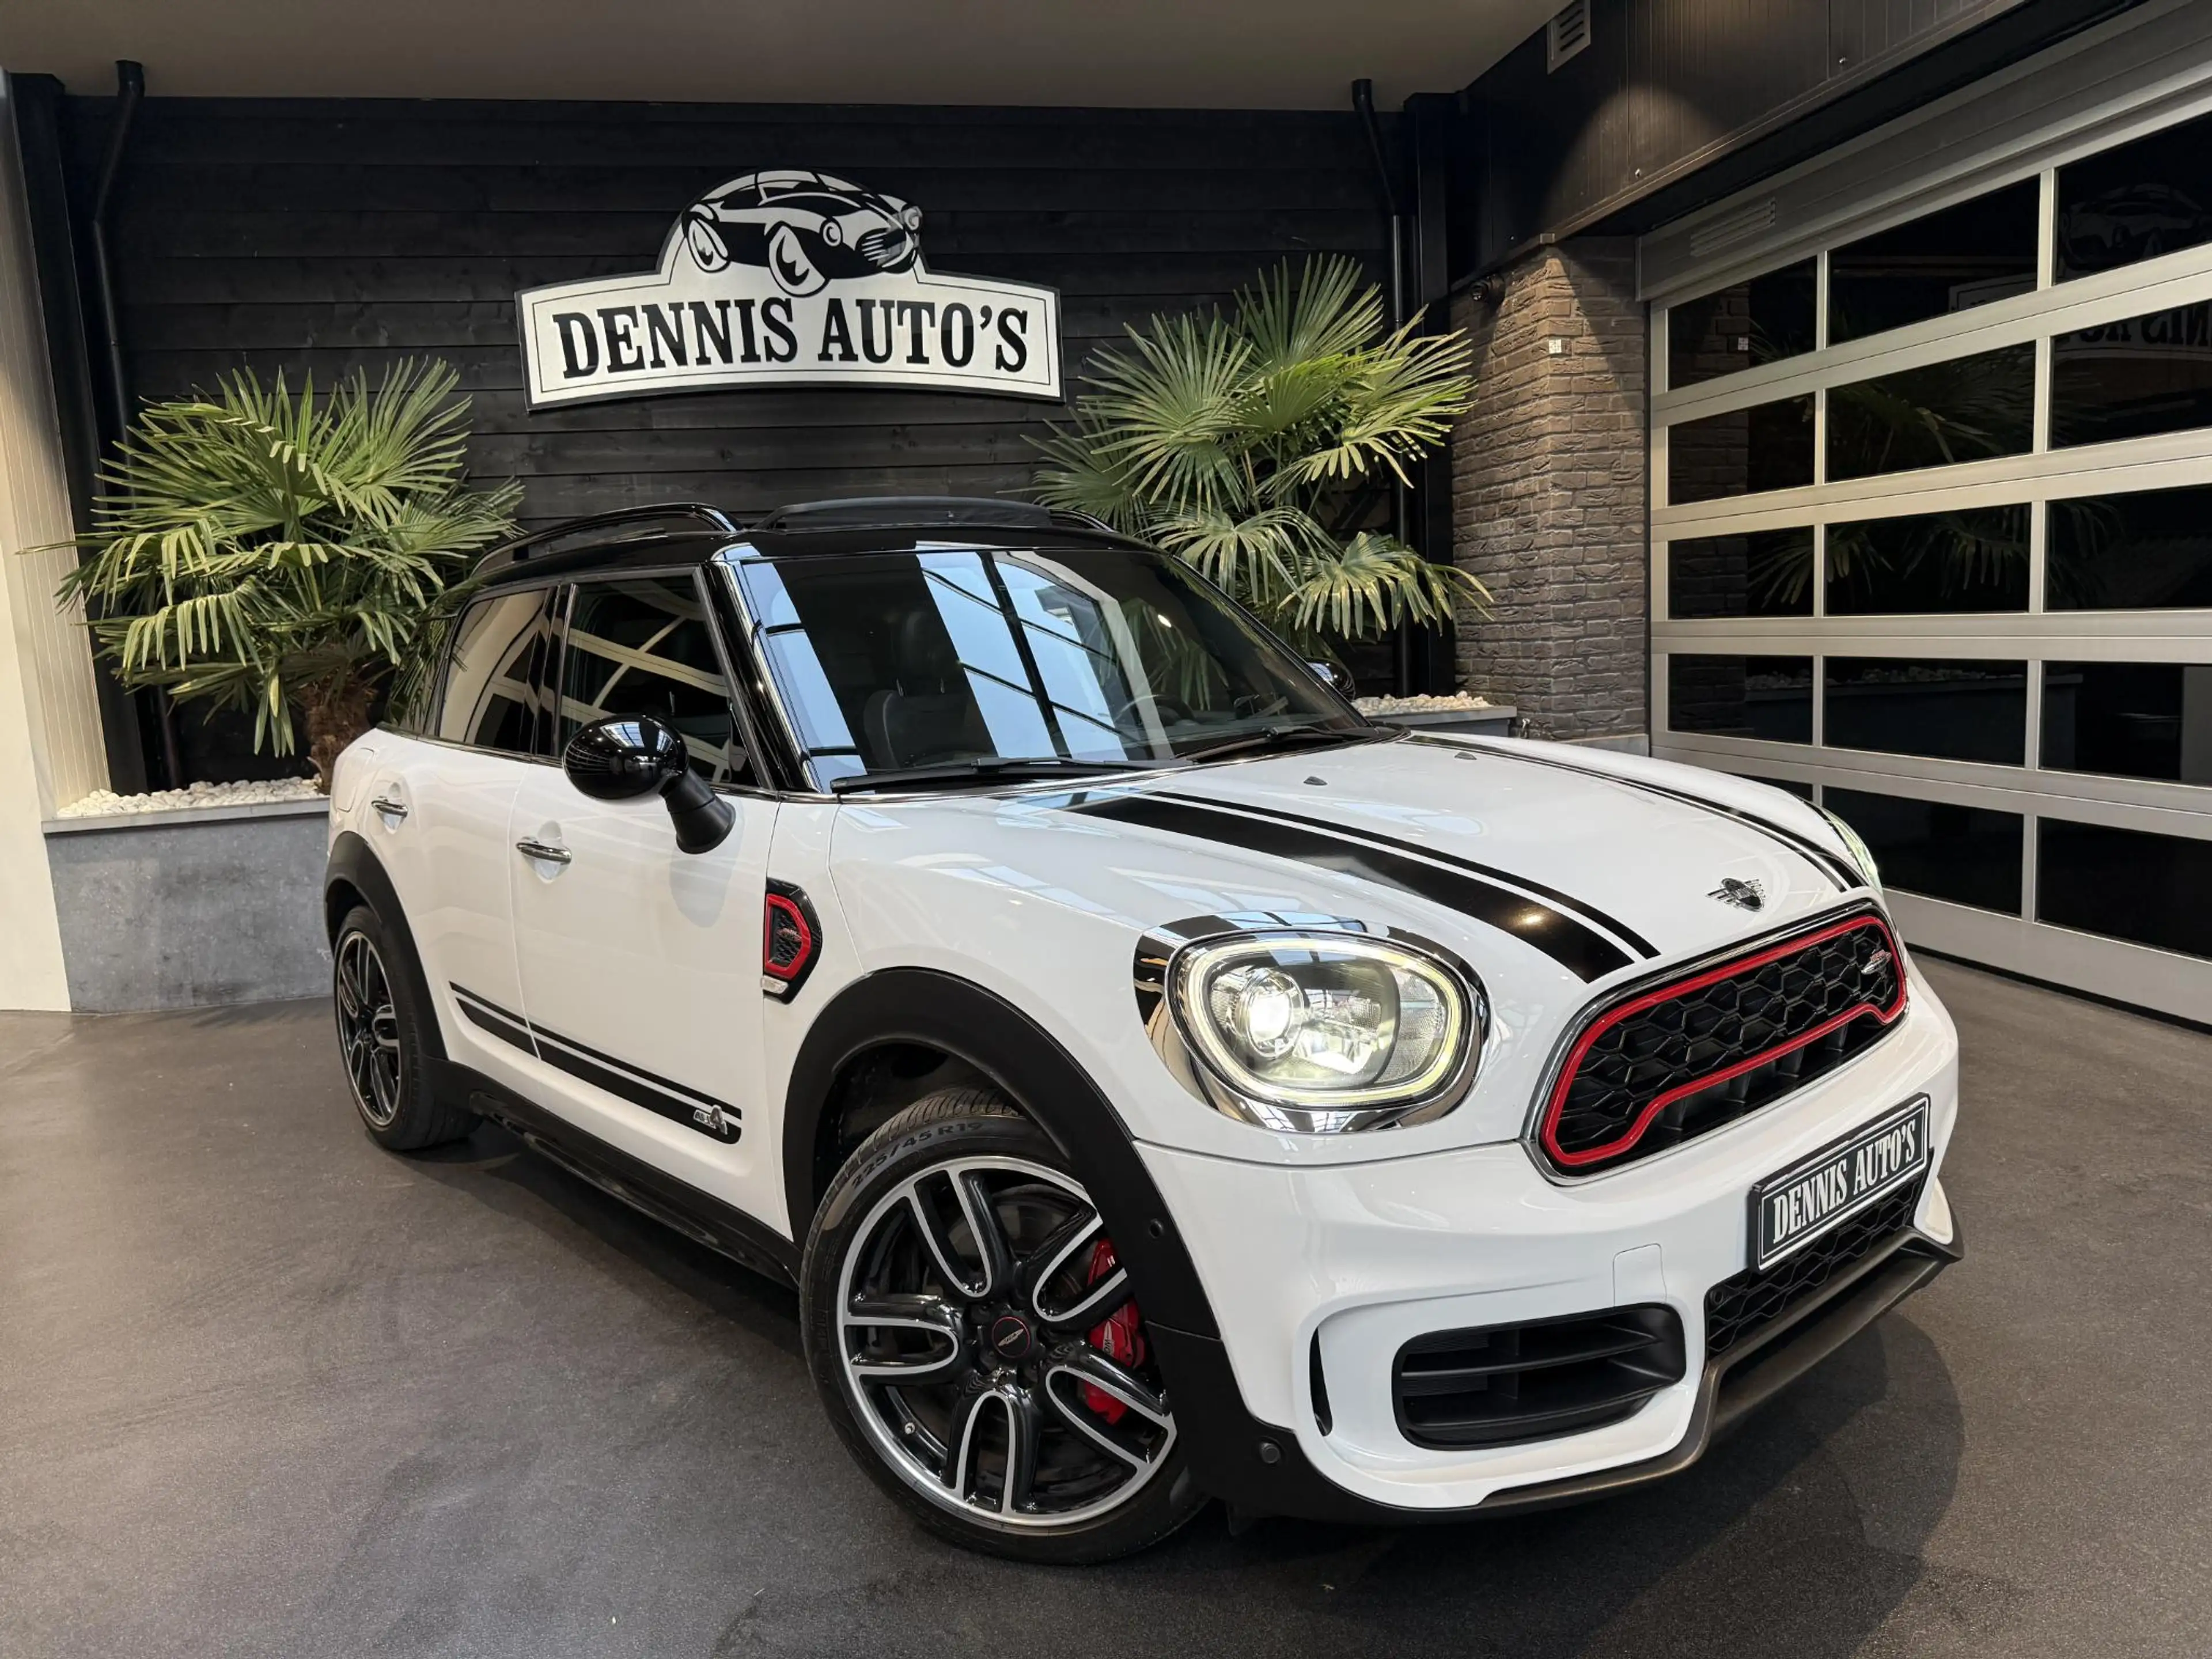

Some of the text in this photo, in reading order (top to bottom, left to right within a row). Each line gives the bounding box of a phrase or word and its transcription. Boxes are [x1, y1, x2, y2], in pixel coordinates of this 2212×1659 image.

[552, 297, 1029, 379] DENNIS AUTO'S
[851, 1130, 933, 1188] 225/45
[1773, 1118, 1916, 1244] DENNIS AUTO'S
